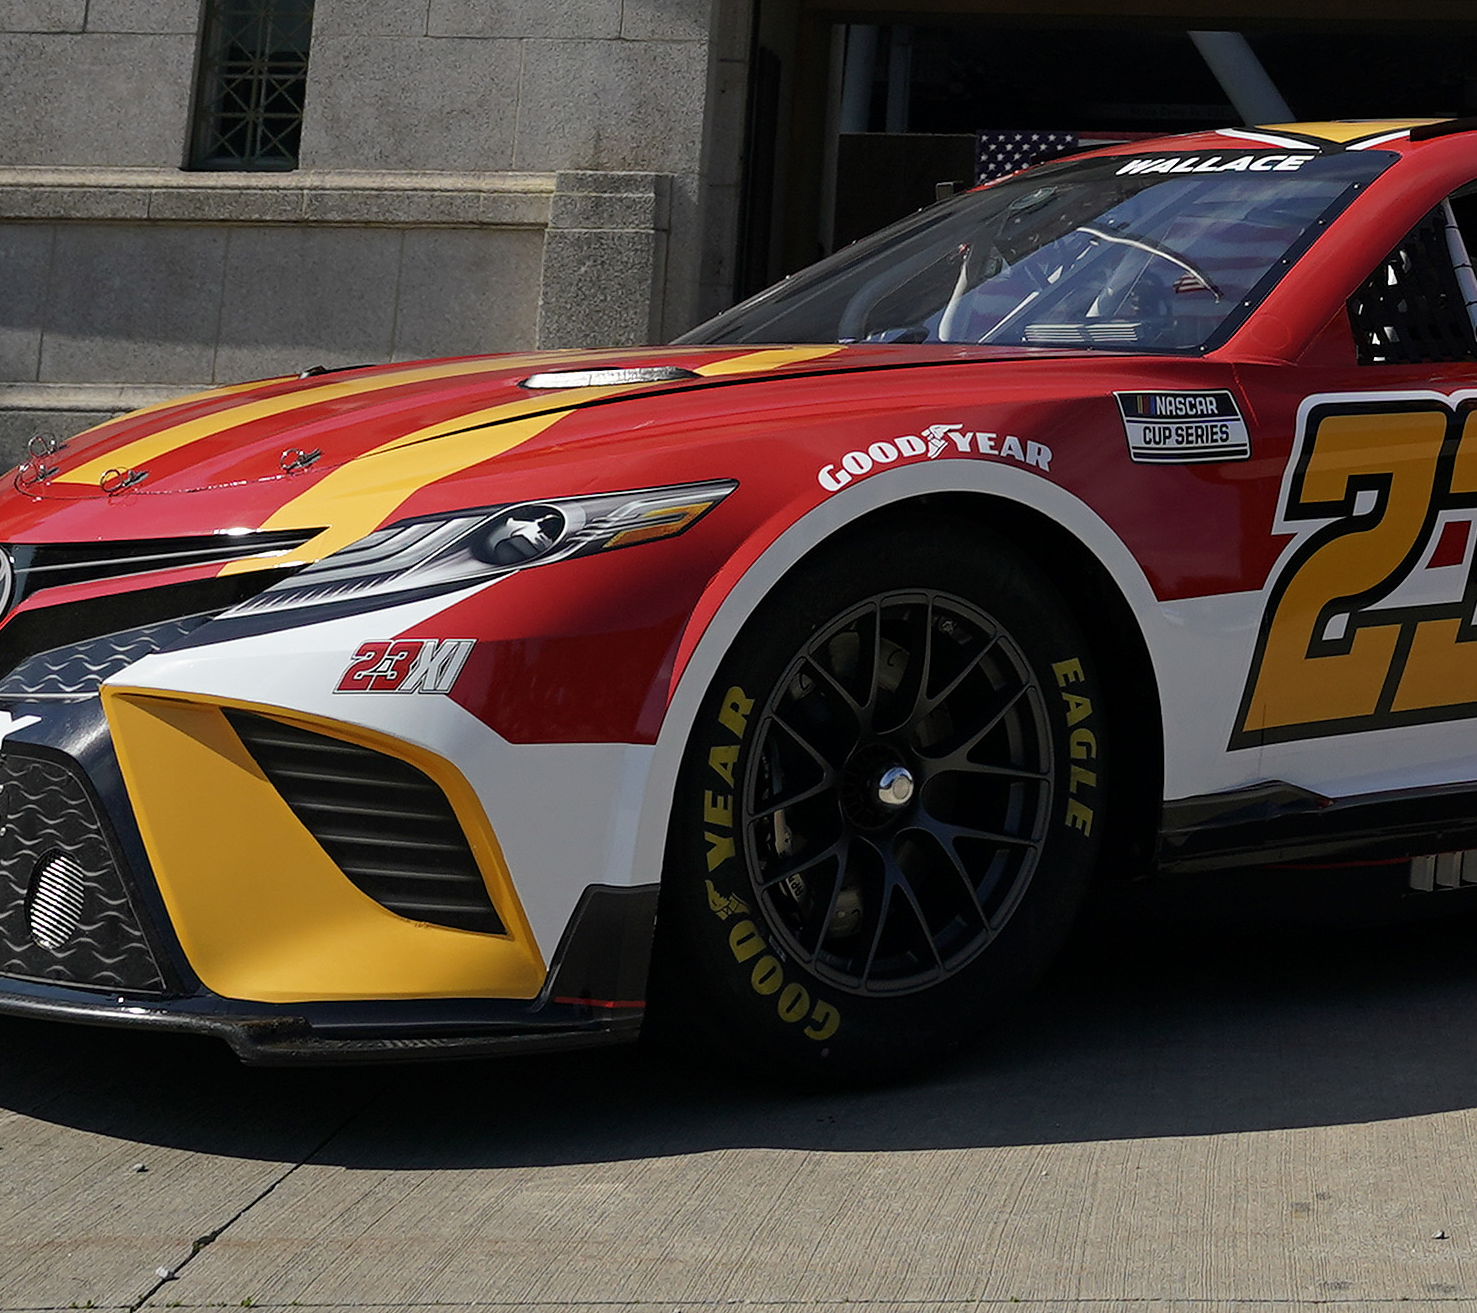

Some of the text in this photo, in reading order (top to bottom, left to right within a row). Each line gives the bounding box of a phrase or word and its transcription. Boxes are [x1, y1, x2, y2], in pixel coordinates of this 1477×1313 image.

[1116, 155, 1315, 176] WALLACE
[1154, 394, 1219, 417] NASCAR
[1142, 424, 1230, 446] CUP SERIES
[1051, 657, 1098, 838] EAGLE
